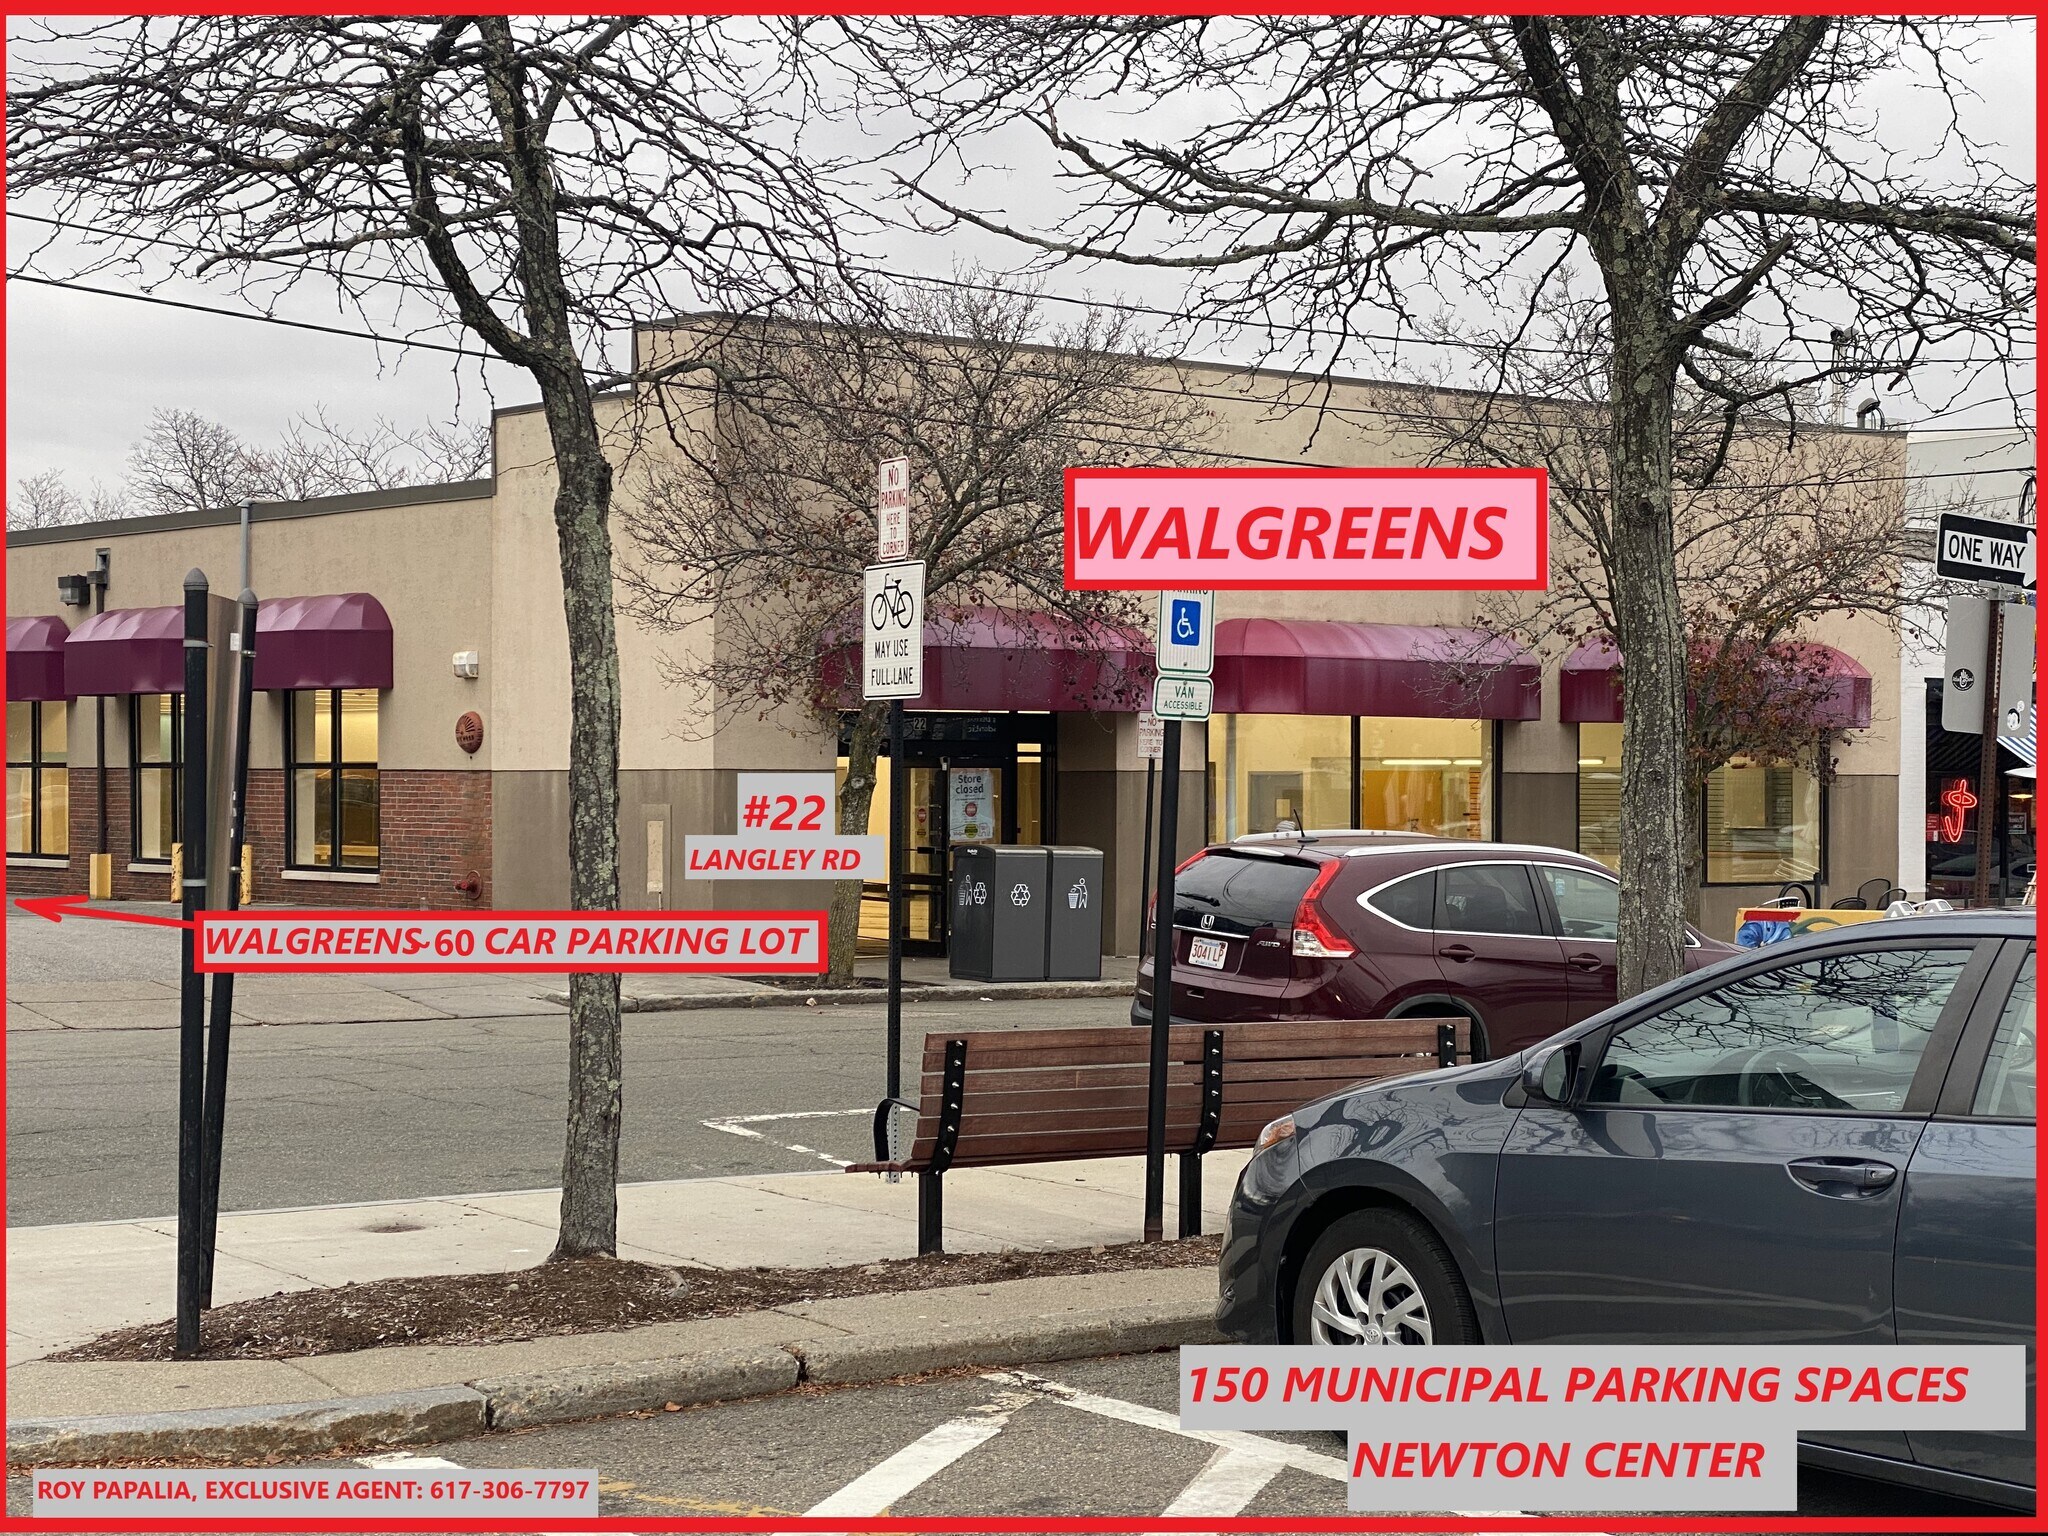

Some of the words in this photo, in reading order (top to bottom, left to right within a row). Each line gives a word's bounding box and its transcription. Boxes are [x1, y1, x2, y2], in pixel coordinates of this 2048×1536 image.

[888, 467, 900, 488] NO
[881, 490, 907, 510] PARKING
[886, 511, 901, 526] HERE
[889, 526, 898, 540] TO
[883, 540, 905, 556] CORNER
[1948, 533, 1982, 564] ONE
[1989, 540, 2026, 570] WAY
[874, 640, 891, 659] MAY
[893, 638, 909, 657] USE
[871, 668, 891, 687] FULL
[893, 666, 914, 685] LANE
[1174, 685, 1195, 699] VAN
[1163, 700, 1203, 711] ACCESSIBLE
[913, 718, 926, 730] 22
[1147, 718, 1157, 727] NO
[1139, 728, 1164, 737] PARKING
[958, 774, 982, 784] Store
[955, 784, 984, 794] closed
[1191, 944, 1211, 961] 3041
[1212, 946, 1224, 962] LP
